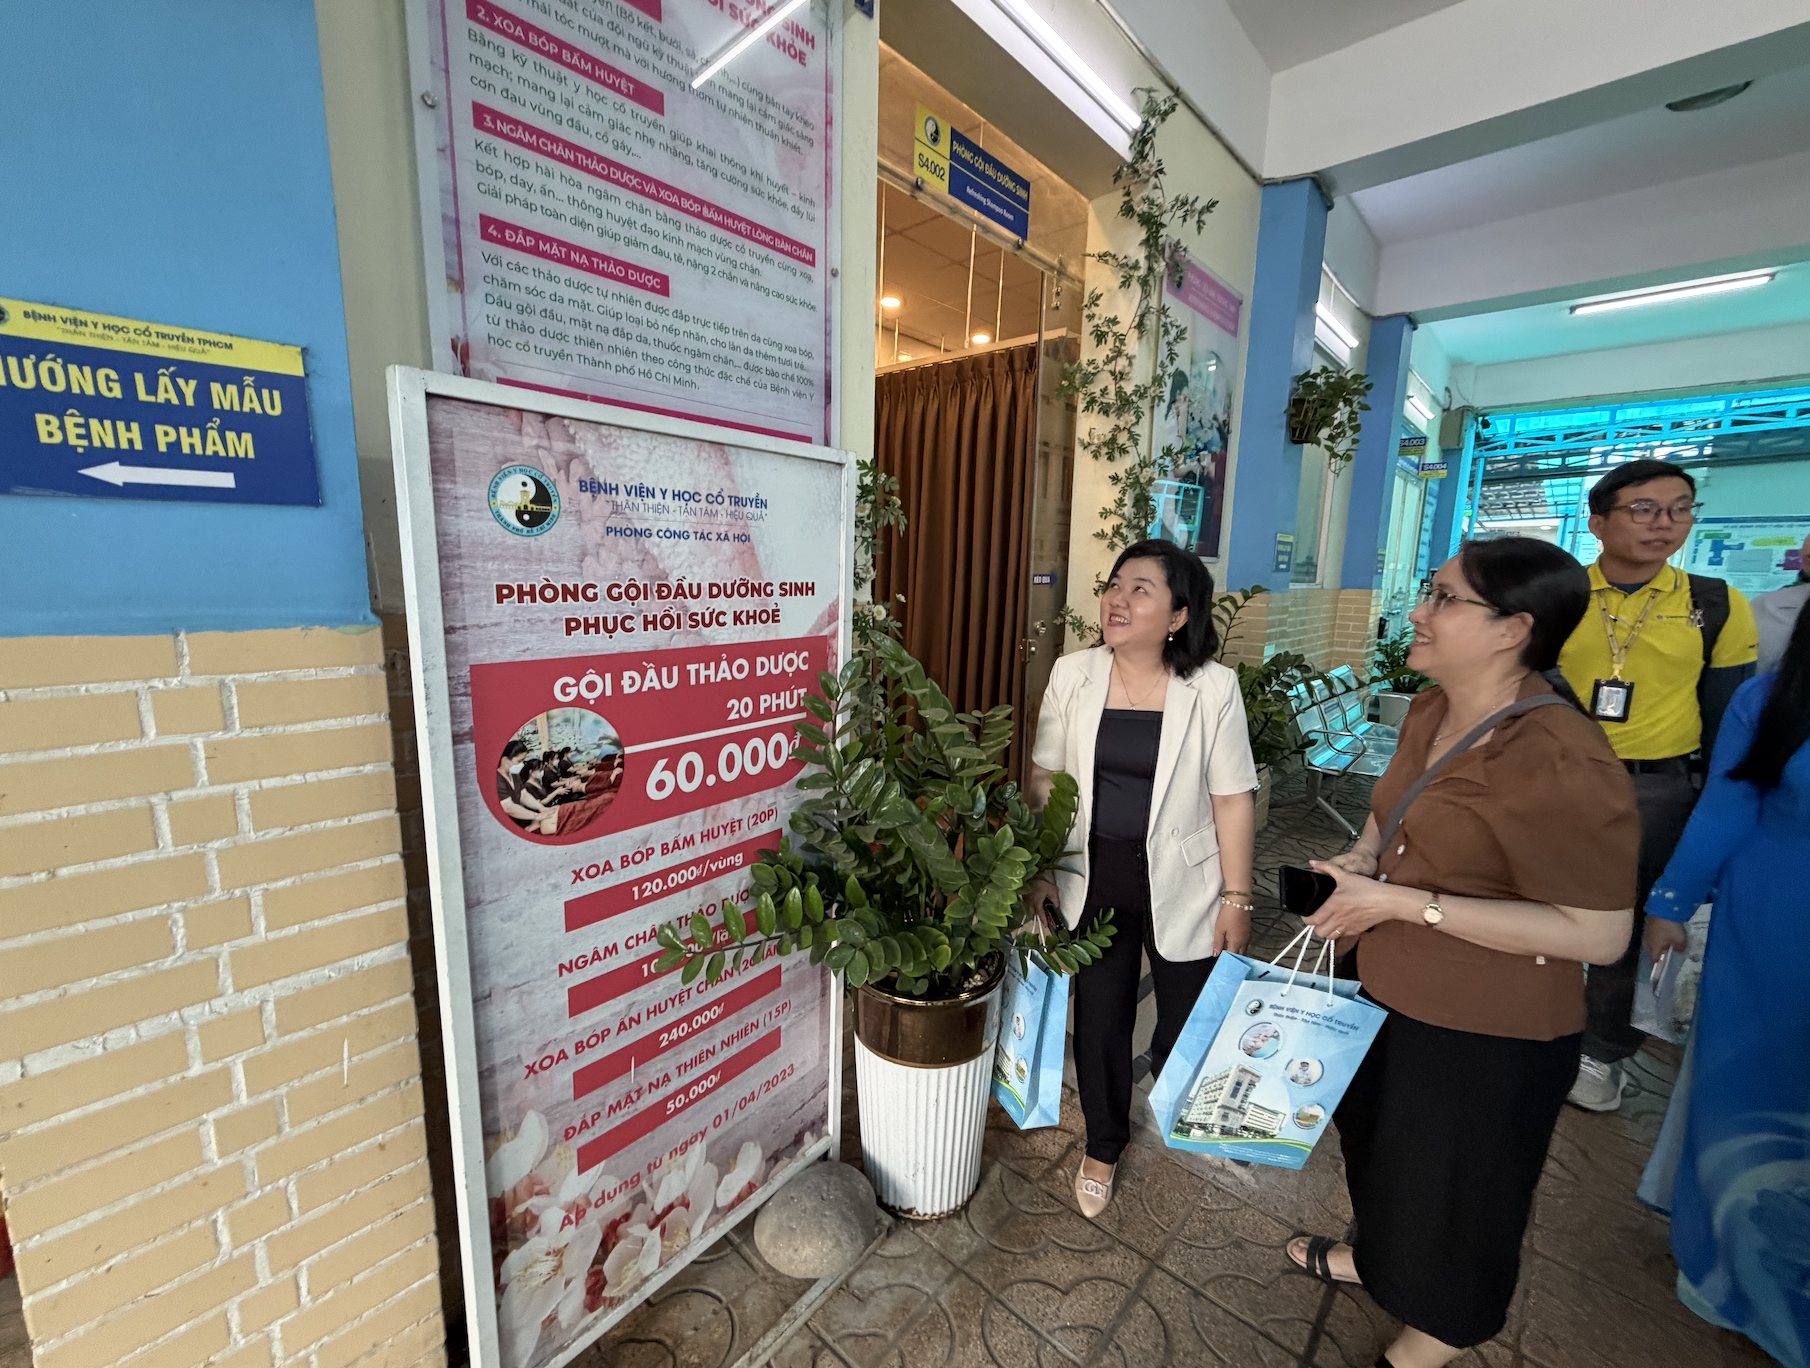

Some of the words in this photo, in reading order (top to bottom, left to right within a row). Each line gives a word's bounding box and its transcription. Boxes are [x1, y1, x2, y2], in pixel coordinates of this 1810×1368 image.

[477, 5, 490, 22] 2.
[492, 12, 525, 40] XOA
[528, 31, 558, 54] BÓP
[561, 48, 591, 73] BẤM
[594, 65, 634, 94] HUYỆT
[918, 152, 945, 181] S4.002
[953, 141, 973, 164] PHÒNG
[483, 114, 494, 130] 3.
[496, 118, 536, 146] NGÂM
[538, 137, 574, 162] CHÂN
[574, 151, 608, 175] THẢO
[609, 166, 642, 189] DƯỢC
[642, 180, 657, 196] VÀ
[658, 187, 680, 205] XOA
[680, 196, 701, 212] BÓP
[701, 204, 723, 223] BẤM
[723, 215, 751, 235] HUYỆT
[751, 227, 774, 245] LÒNG
[774, 237, 791, 252] BÀN
[791, 245, 812, 261] CHÂN
[488, 225, 501, 238] 4.
[504, 228, 535, 247] ĐẮP
[538, 239, 567, 258] MẶT
[570, 249, 589, 267] NẠ
[590, 256, 625, 277] THẢO
[627, 268, 660, 288] DƯỢC
[23, 310, 56, 324] BỆNH
[61, 316, 88, 329] VIỆN
[91, 321, 98, 329] Y
[103, 323, 130, 335] HỌC
[134, 326, 152, 337] CỔ
[155, 330, 194, 344] TRUYỀN
[198, 338, 233, 350] TPHCM
[486, 331, 512, 349] học
[514, 339, 531, 352] cổ
[533, 343, 573, 362] truyền
[575, 352, 612, 371] Thành
[614, 362, 636, 376] phố
[637, 366, 652, 379] Hồ
[654, 370, 671, 384] Chí
[672, 374, 700, 390] Minh.
[134, 366, 197, 406] LẤY
[210, 376, 282, 416] MẪU
[35, 409, 143, 453] BỆNH
[155, 418, 255, 459] PHẨM
[579, 478, 619, 496] BỆNH
[624, 483, 655, 500] VIỆN
[660, 488, 668, 500] Y
[672, 490, 701, 506] HỌC
[706, 488, 724, 504] CỔ
[728, 493, 767, 509] TRUYỀN
[642, 502, 669, 515] THIỆN
[679, 506, 696, 518] TẬN
[699, 506, 718, 518] TÂM
[726, 510, 743, 521] HIỆU
[606, 524, 652, 538] PHÒNG
[657, 527, 689, 540] CÔNG
[693, 530, 712, 541] TÁC
[716, 531, 730, 542] XÃ
[733, 532, 750, 544] HỘI
[495, 579, 598, 604] PHÒNG
[606, 579, 648, 607] GỘI
[656, 576, 702, 600] ĐẦU
[709, 579, 774, 598] DƯỠNG
[779, 582, 815, 597] SINH
[565, 615, 636, 640] PHỤC
[643, 606, 682, 631] HỒI
[688, 607, 728, 627] SỨC
[554, 669, 612, 705] GỘI
[621, 661, 679, 694] ĐẦU
[687, 654, 749, 686] THẢO
[756, 651, 809, 678] DƯỢC
[727, 697, 753, 721] 20
[760, 686, 807, 715] PHÚT
[571, 860, 614, 885] XOA
[620, 846, 655, 870] BÓP
[661, 833, 695, 857] BẤM
[700, 818, 743, 843] HUYỆT
[747, 807, 778, 830] (20P)
[558, 942, 619, 978] NGÂM
[524, 1048, 569, 1080] XOA
[574, 1026, 611, 1056] BÓP
[616, 1011, 641, 1036] ẤN
[646, 988, 693, 1022] HUYỆT
[563, 1110, 601, 1142] ĐẮP
[607, 1086, 643, 1119] MẶT
[648, 1071, 672, 1094] NẠ
[676, 1046, 716, 1078] THIÊN
[720, 1019, 759, 1053] NHIÊN
[763, 999, 792, 1027] (15P)
[594, 1170, 641, 1210] dụng
[647, 1156, 663, 1174] từ
[669, 1126, 708, 1160] ngày
[713, 1063, 795, 1129] 01/04/2023
